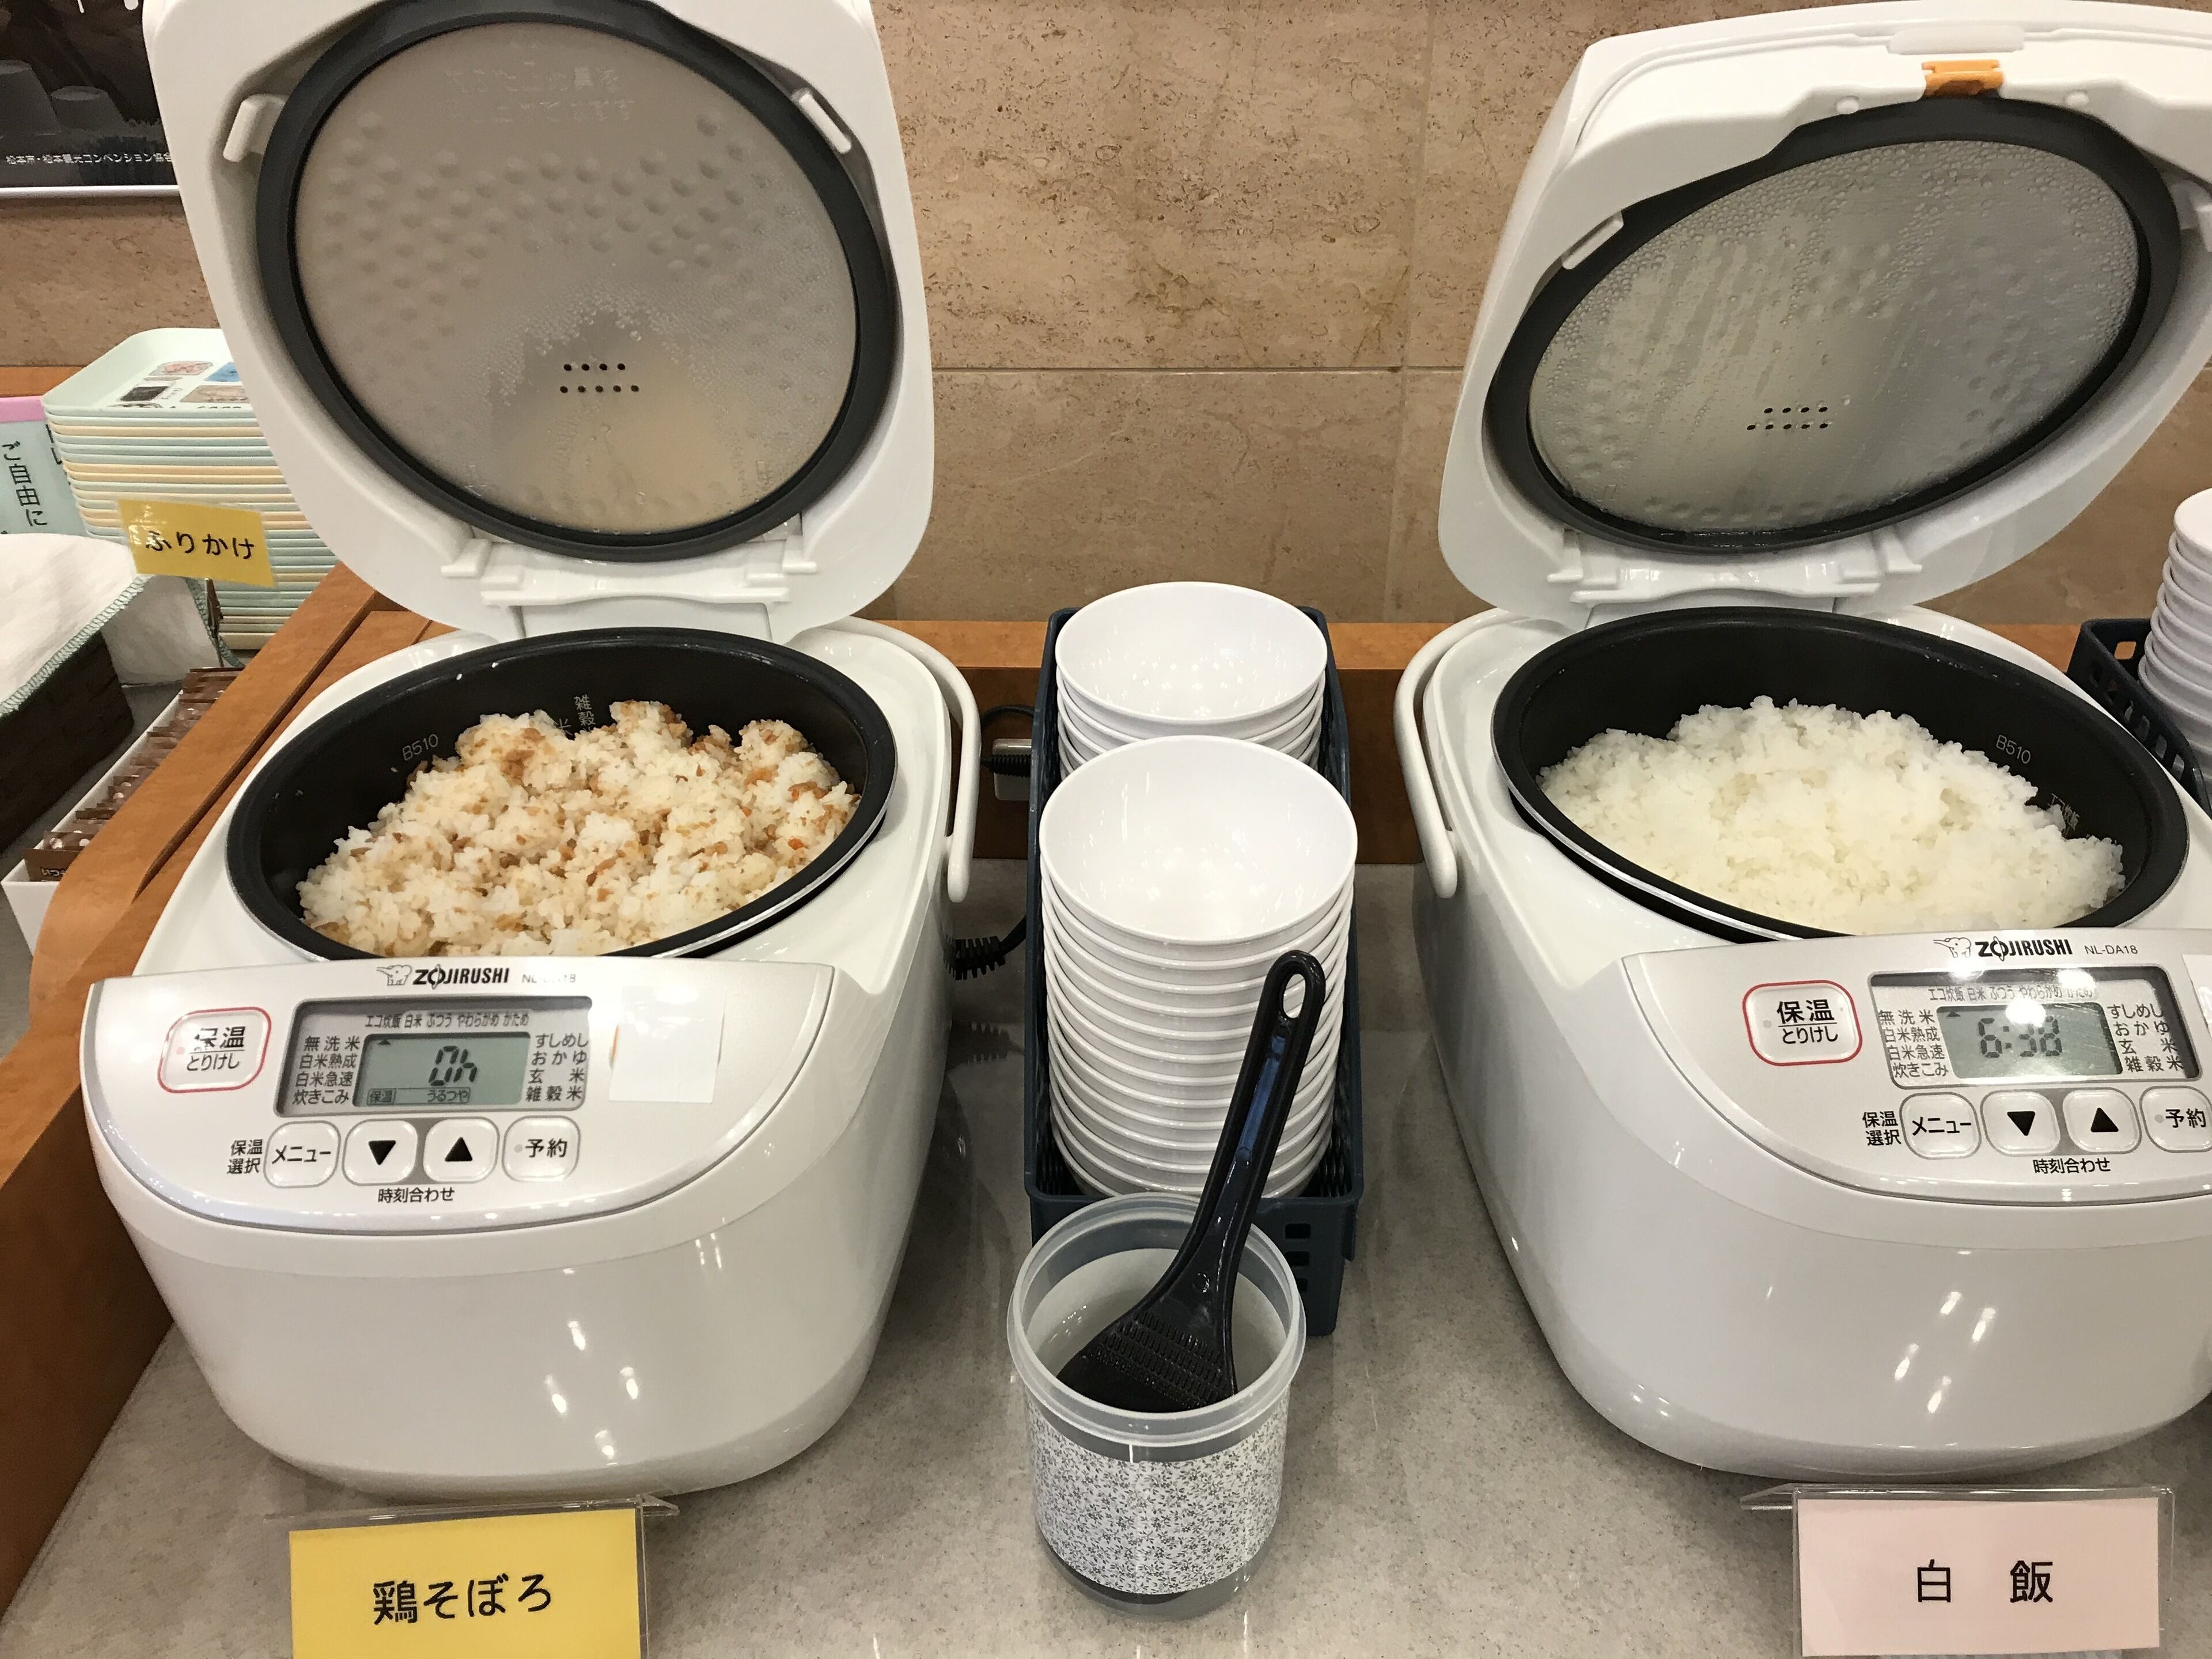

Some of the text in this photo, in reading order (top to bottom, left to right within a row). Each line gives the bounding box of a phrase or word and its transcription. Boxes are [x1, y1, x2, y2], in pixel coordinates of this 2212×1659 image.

[2, 441, 47, 527] ご自由に
[145, 530, 255, 559] ふりかけ
[573, 694, 596, 732] 雑穀
[402, 733, 439, 761] B510
[1996, 734, 2031, 764] B510
[1975, 936, 2139, 962] ZOJIRUSHI NL-DA18
[412, 963, 510, 990] ZOJIRUSHI
[1777, 999, 1835, 1024] 保温
[2107, 1003, 2164, 1019] すしめし
[536, 1033, 589, 1048] すしめし
[1782, 1025, 1838, 1044] とりけし
[1883, 1026, 1941, 1043] 白米熟成
[1887, 1044, 1945, 1060] 白米急速
[186, 1053, 240, 1071] とりけし
[299, 1054, 358, 1069] 白米熟成
[1892, 1062, 1949, 1078] 炊きこみ
[295, 1071, 354, 1088] 白米急速
[292, 1089, 350, 1105] 炊きこみ
[1862, 1111, 1899, 1128] 保温
[1912, 1116, 1971, 1136] メニュー
[2165, 1108, 2207, 1128] 予約
[1865, 1129, 1902, 1146] 選択
[230, 1139, 263, 1156] 保温
[271, 1145, 331, 1164] メニュー
[525, 1138, 567, 1158] 予約
[226, 1157, 260, 1175] 選択
[2032, 1157, 2111, 1174] 時刻合わせ
[377, 1187, 455, 1203] 時刻合わせ
[372, 1573, 552, 1625] 鶏そぼろ
